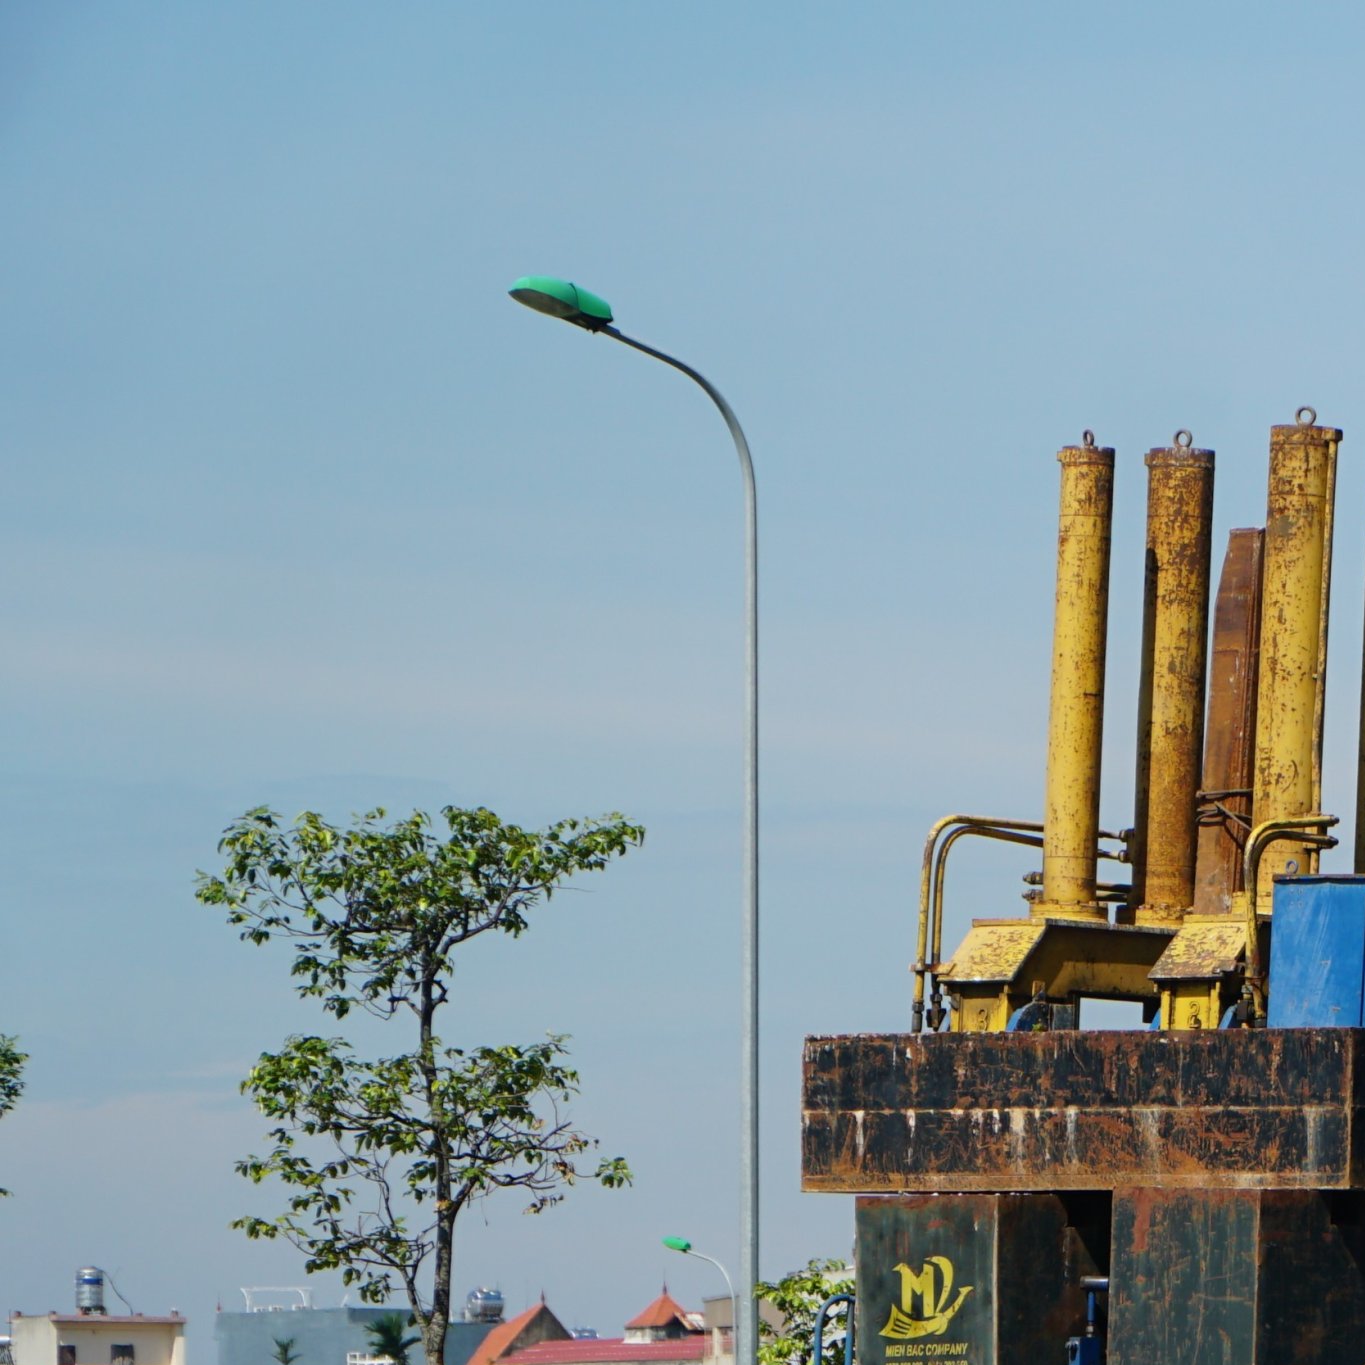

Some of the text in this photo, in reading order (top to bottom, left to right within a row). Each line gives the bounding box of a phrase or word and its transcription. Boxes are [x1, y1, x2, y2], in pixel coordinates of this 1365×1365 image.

[885, 1342, 968, 1357] MIEN BAC COMPANY
